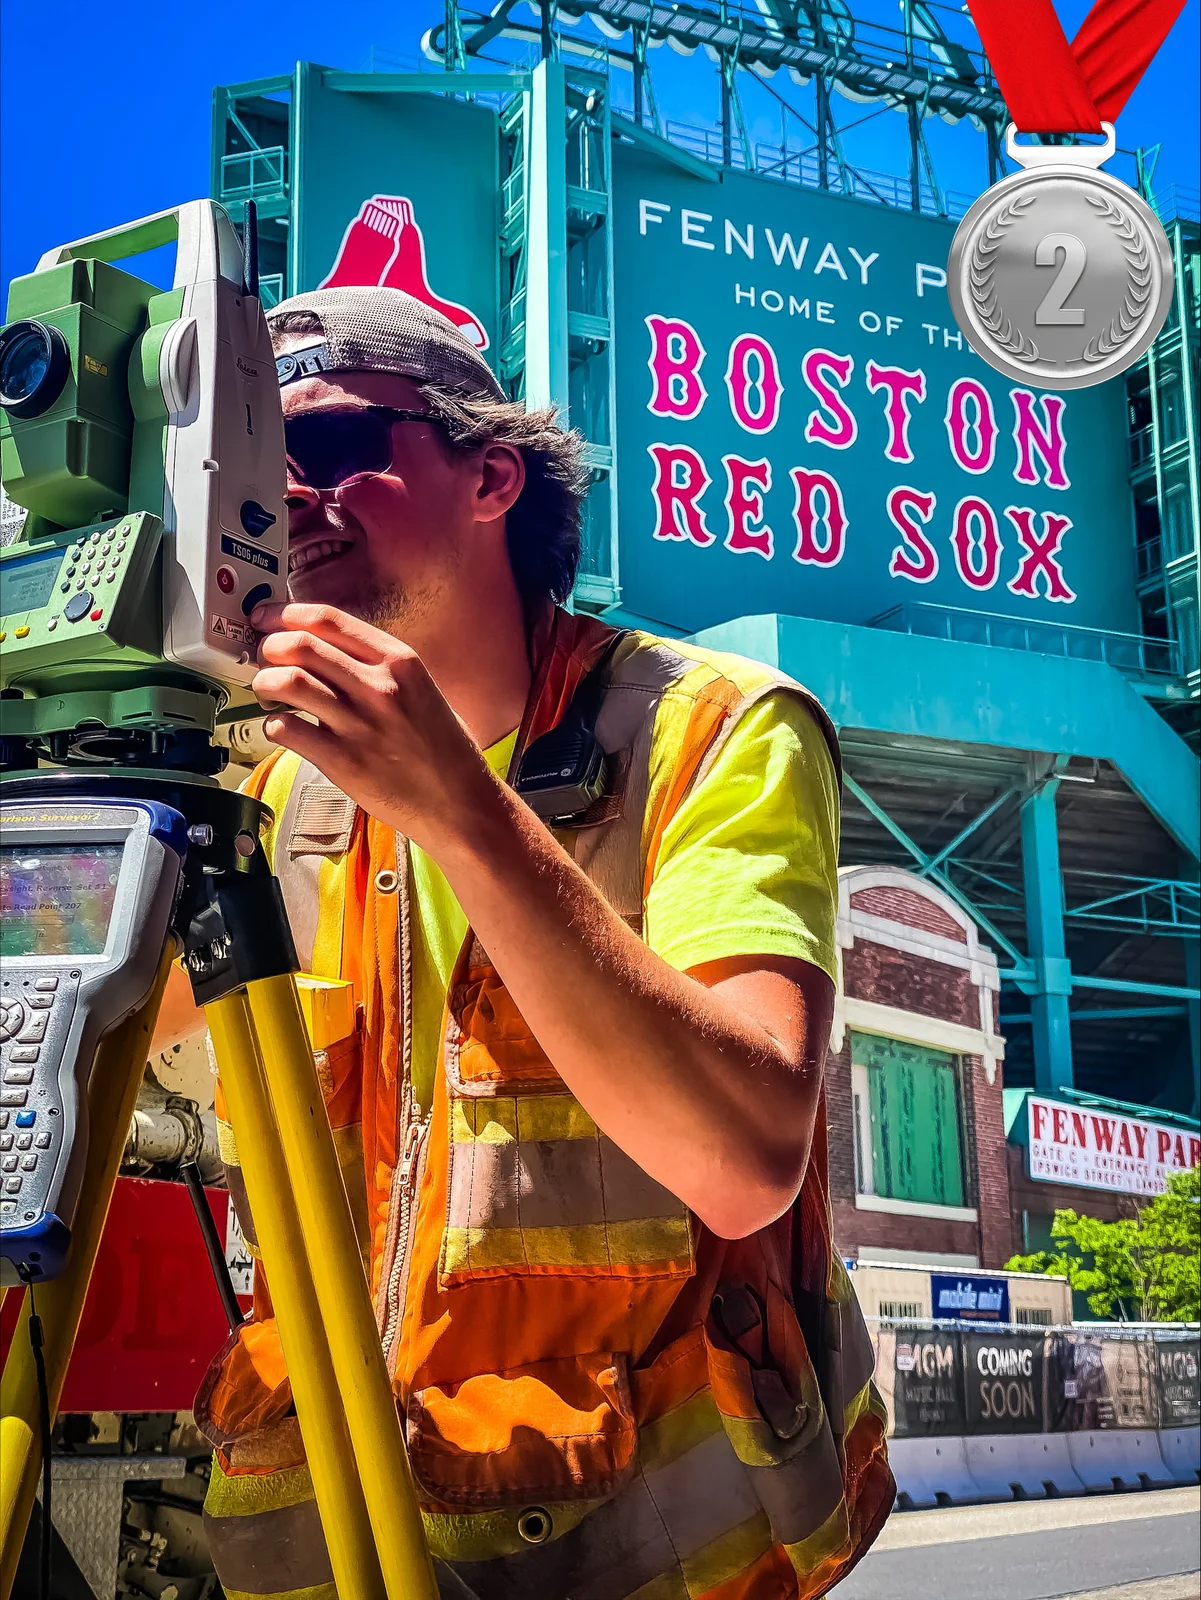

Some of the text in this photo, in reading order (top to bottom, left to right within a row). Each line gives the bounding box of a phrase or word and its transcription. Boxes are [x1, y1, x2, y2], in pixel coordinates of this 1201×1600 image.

[638, 198, 880, 286] FENWAY
[734, 282, 836, 325] HOME
[858, 310, 904, 336] OF
[644, 313, 1071, 490] BOSTON
[647, 442, 1078, 604] RED SOX
[232, 542, 269, 568] TS06 plus
[0, 815, 36, 823] arlson
[14, 903, 37, 911] Read
[65, 902, 82, 910] 207
[1032, 1103, 1200, 1168] FENWAY PAR
[977, 1347, 1033, 1377] COMING
[980, 1380, 1035, 1418] SOON
